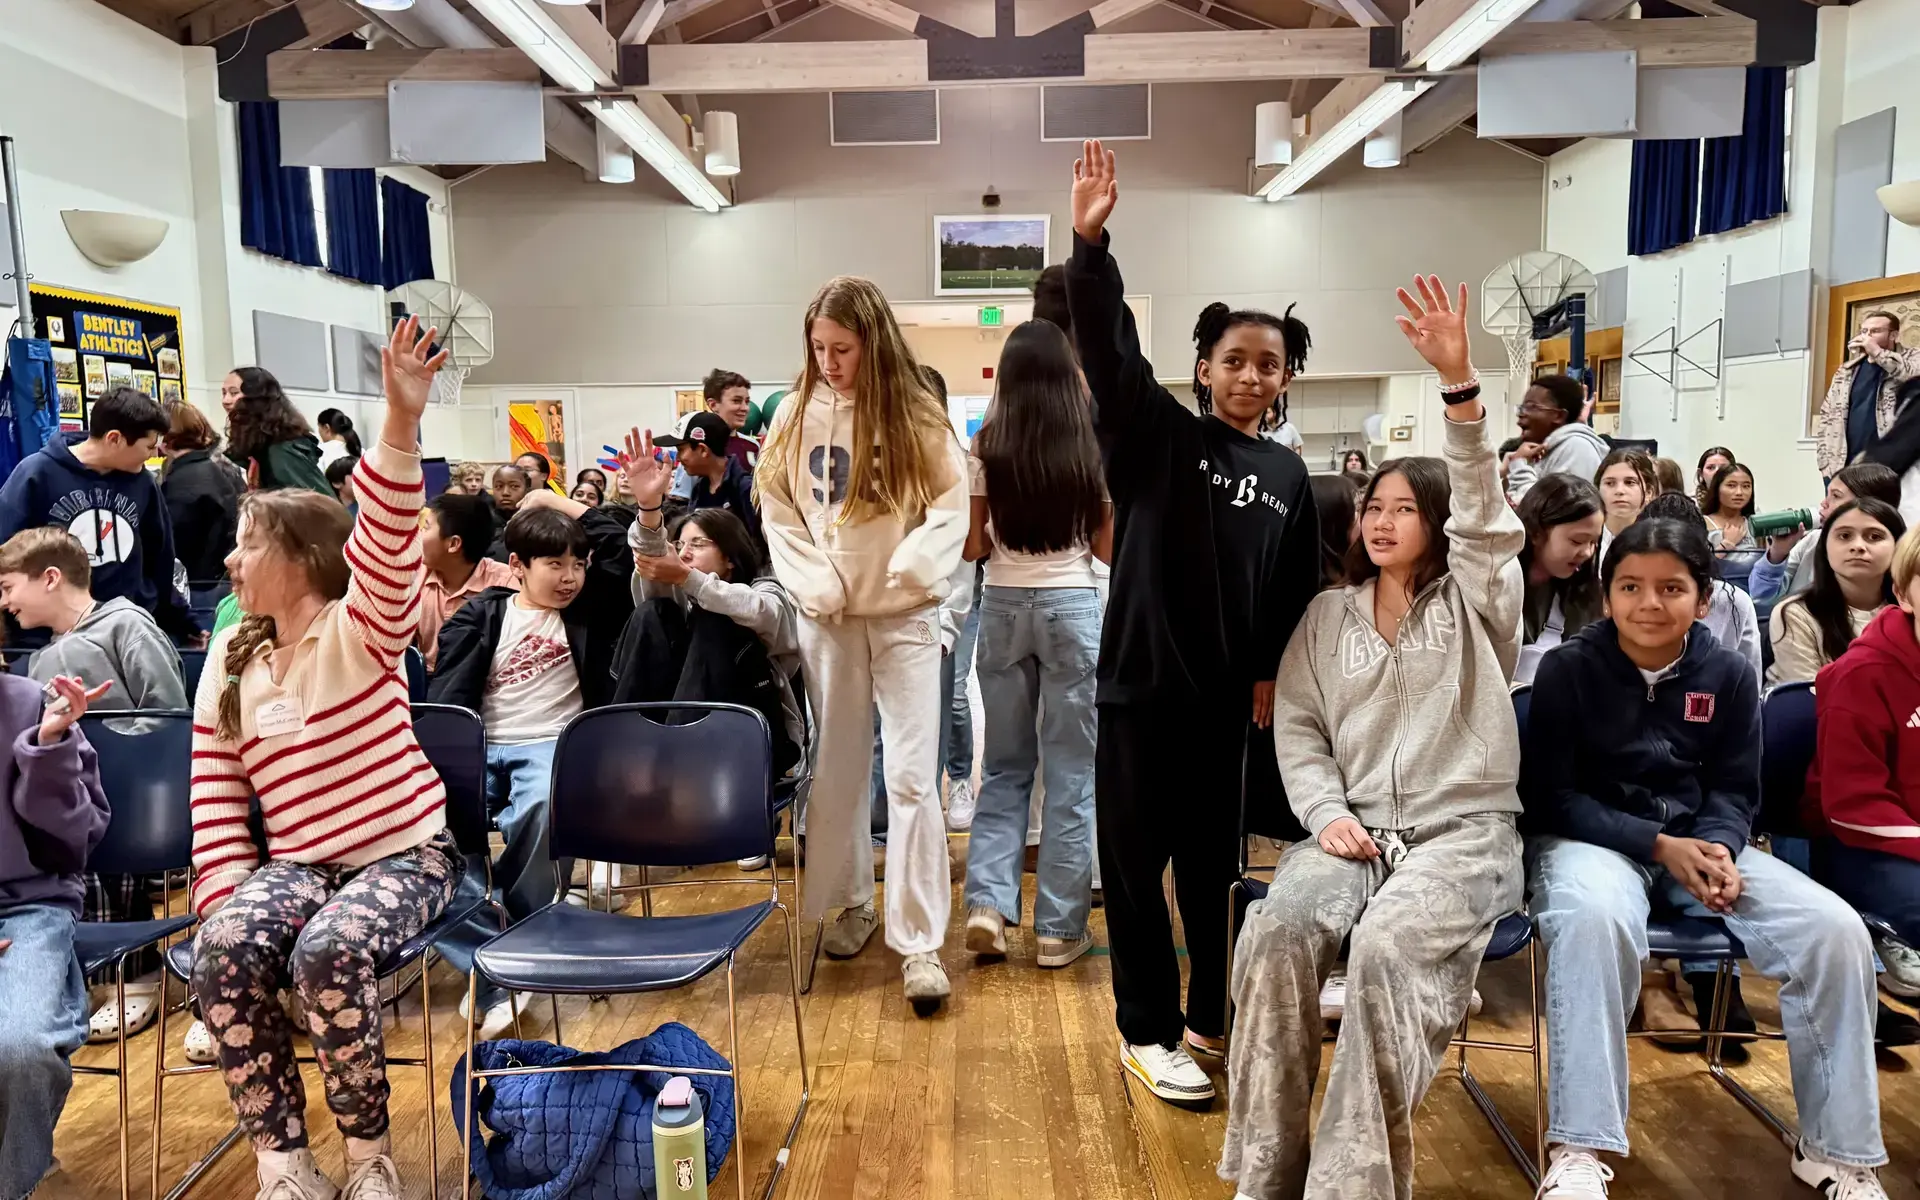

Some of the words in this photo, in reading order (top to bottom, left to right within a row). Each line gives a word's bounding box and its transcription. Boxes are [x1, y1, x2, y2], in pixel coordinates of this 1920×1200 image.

[82, 314, 136, 337] BENTLEY
[79, 333, 144, 357] ATHLETICS
[1230, 473, 1258, 508] B
[1261, 491, 1289, 517] READY
